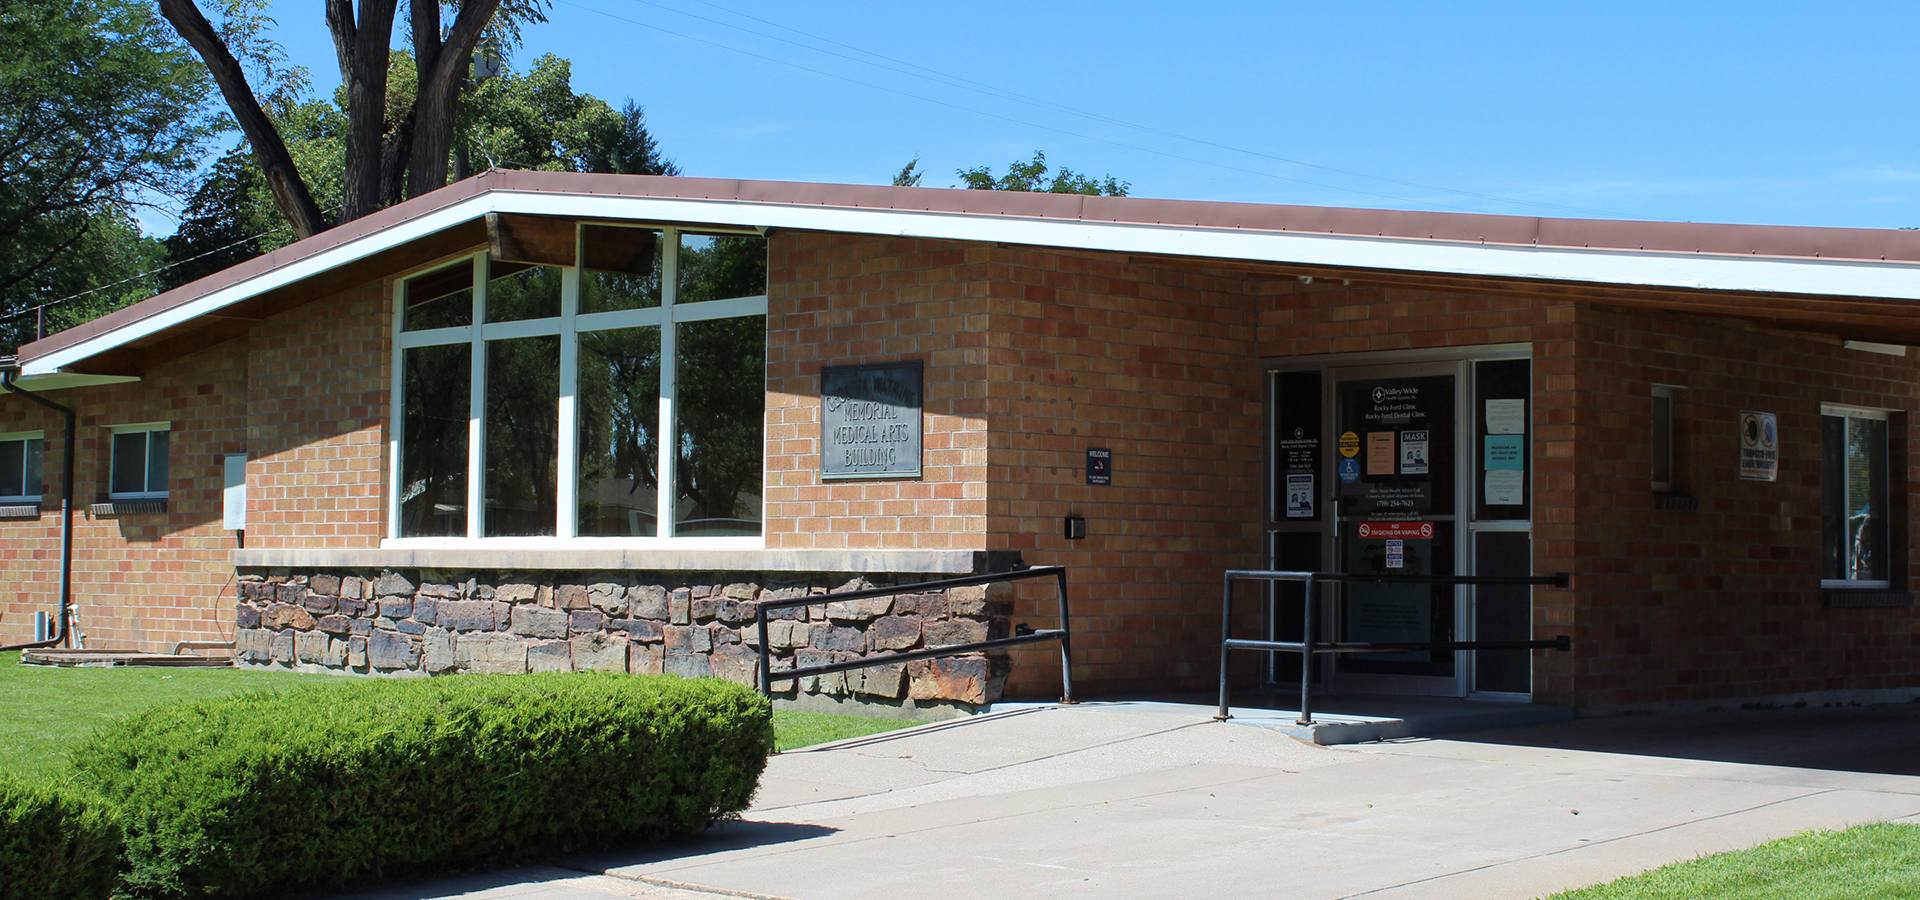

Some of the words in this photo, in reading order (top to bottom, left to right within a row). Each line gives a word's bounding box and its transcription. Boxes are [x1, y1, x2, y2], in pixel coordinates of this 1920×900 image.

[1385, 388, 1402, 396] Valley
[1402, 387, 1419, 395] Wide
[844, 402, 897, 421] MEMORIAL
[833, 425, 877, 444] MEDICAL
[881, 423, 909, 442] ARTS
[1404, 432, 1426, 441] MASK
[844, 447, 897, 467] BUILDING
[1089, 450, 1109, 458] WELCOME
